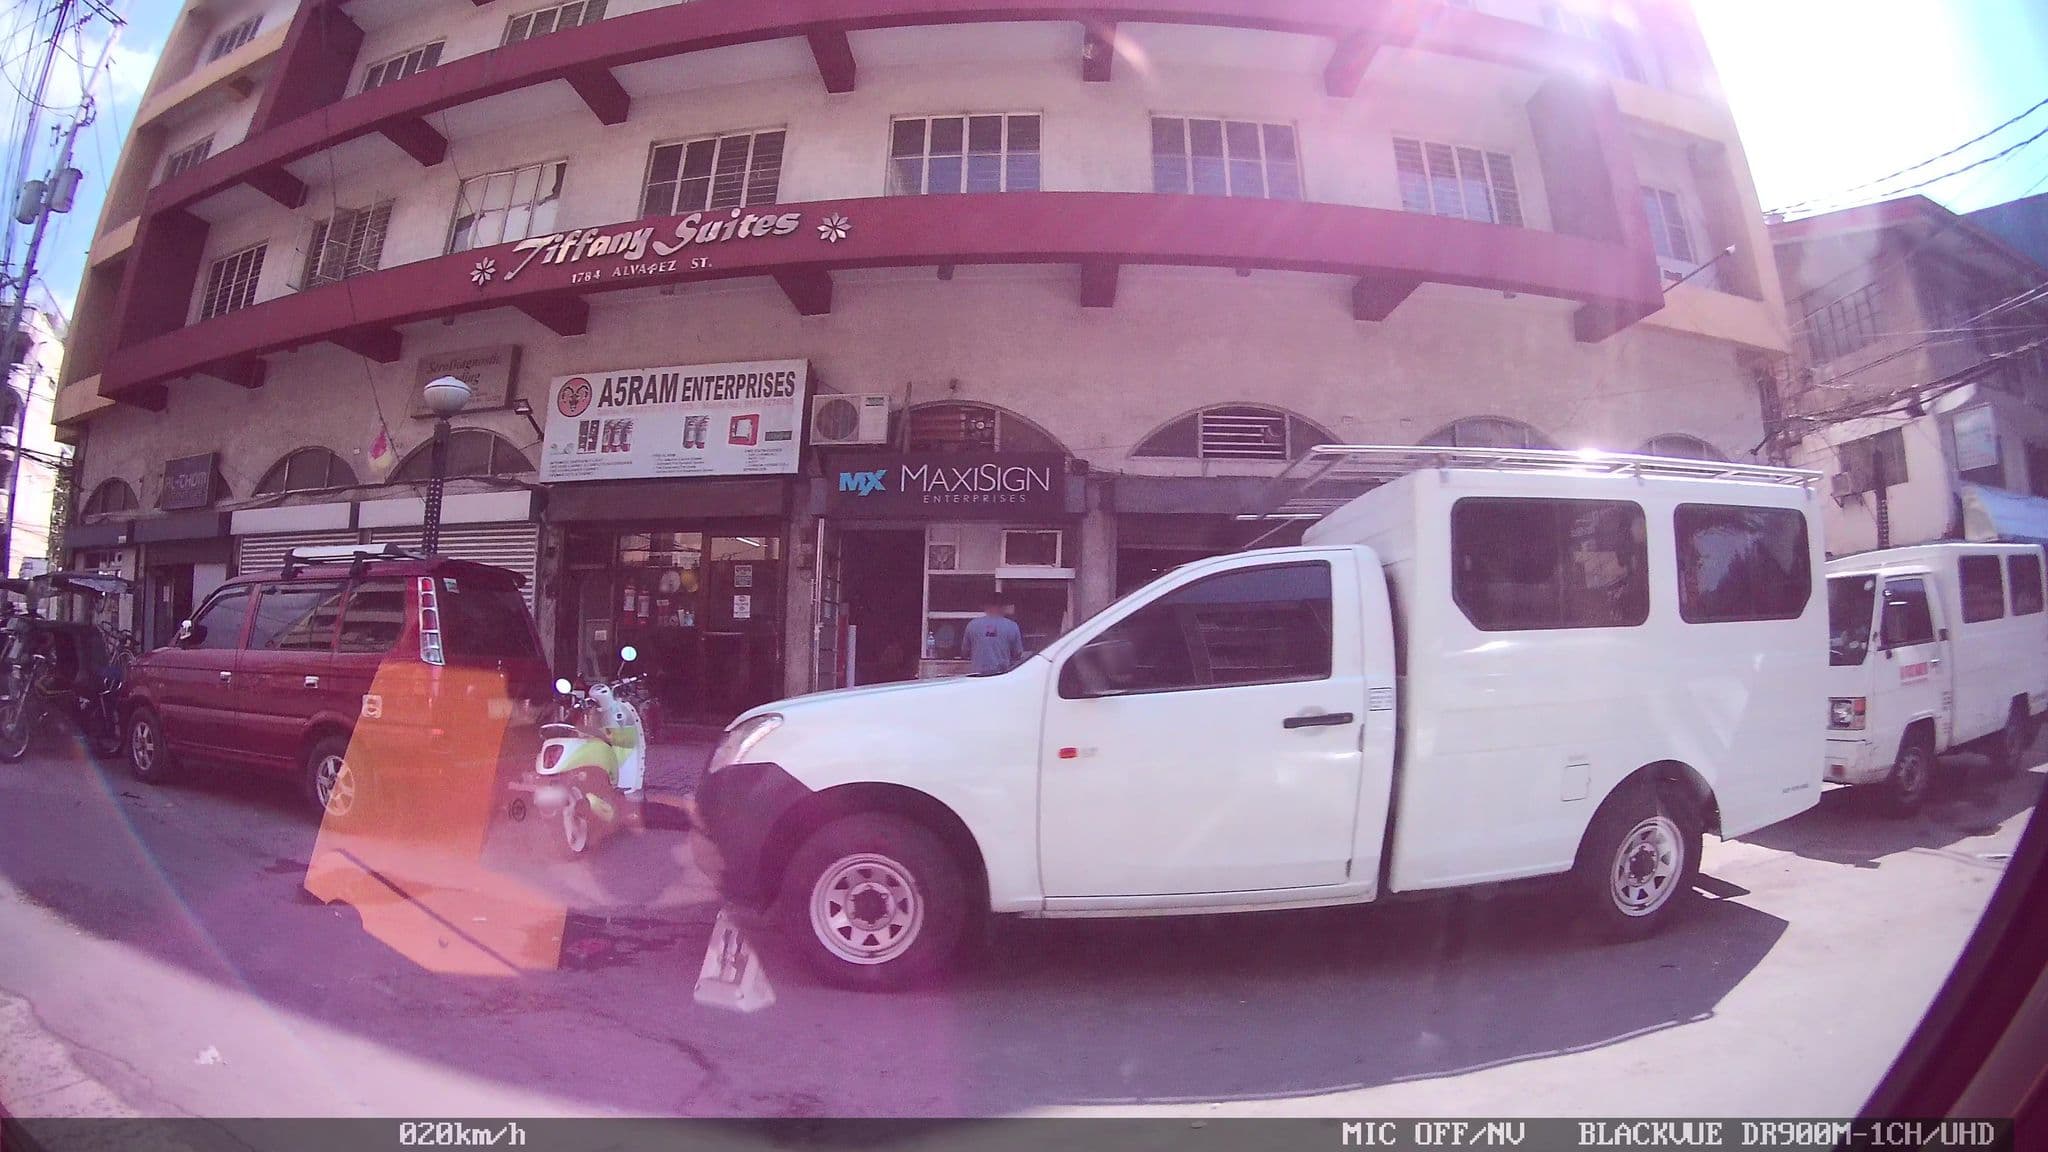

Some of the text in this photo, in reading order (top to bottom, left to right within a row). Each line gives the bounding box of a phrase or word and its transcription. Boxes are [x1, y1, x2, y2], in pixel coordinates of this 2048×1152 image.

[503, 207, 801, 281] Tiffany Suites
[571, 269, 601, 285] 1784
[690, 257, 713, 270] ST.
[598, 371, 796, 408] A5RAM ENTERPRISES
[838, 469, 888, 497] MX
[900, 463, 1050, 493] MAXISIGN
[923, 494, 1027, 504] ENTERPRISES
